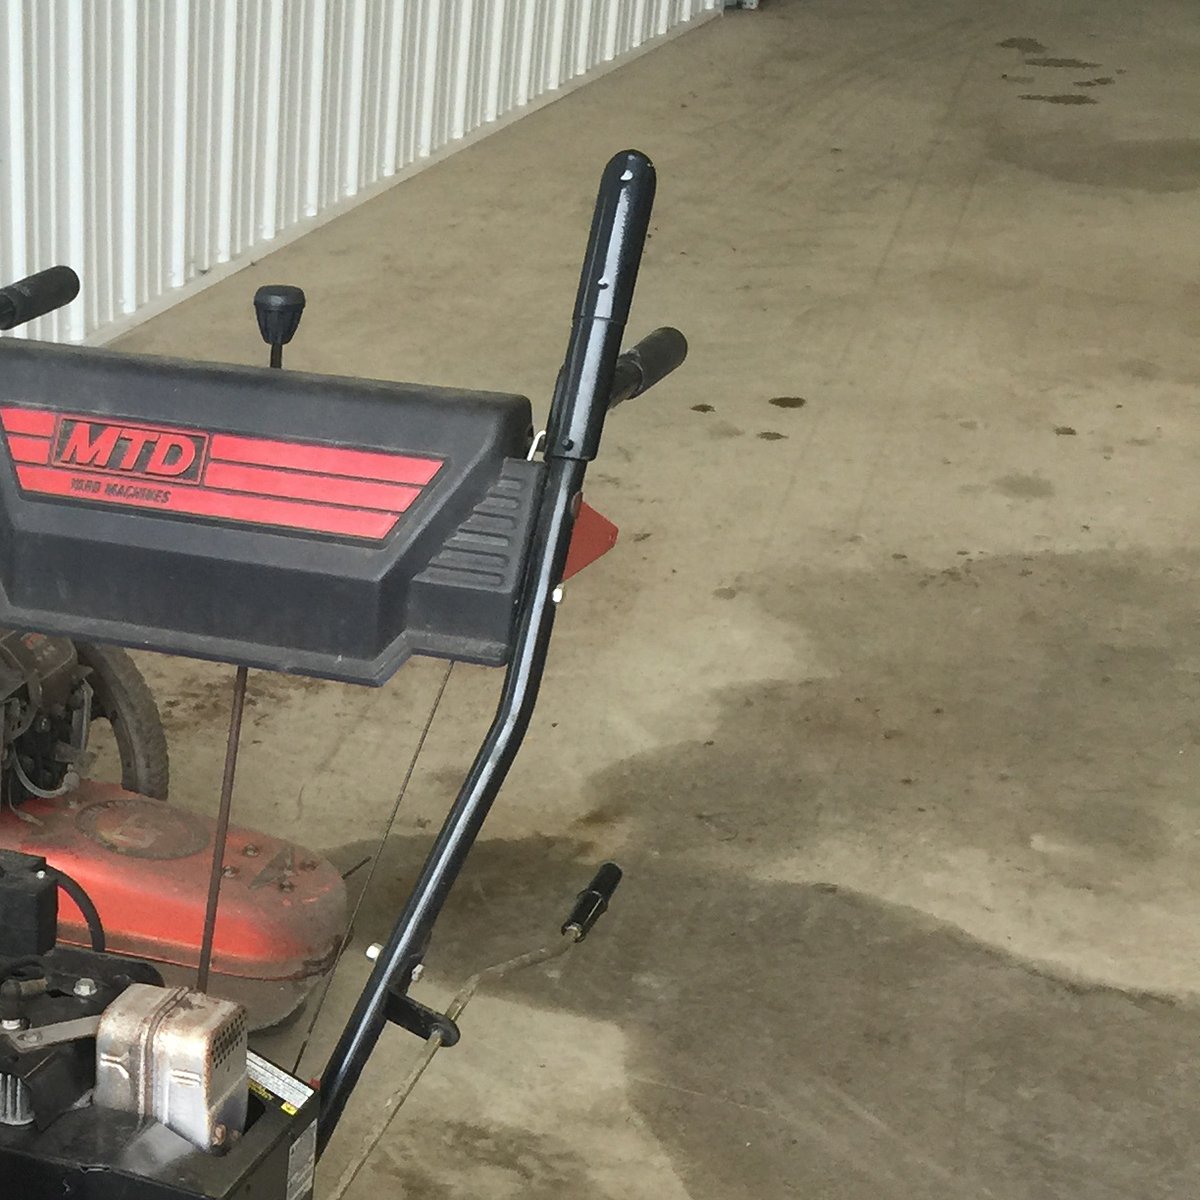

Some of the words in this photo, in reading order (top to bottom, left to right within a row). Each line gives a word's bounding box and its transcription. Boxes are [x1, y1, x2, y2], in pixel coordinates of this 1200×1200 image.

[59, 421, 197, 477] MTD
[70, 478, 102, 494] YARD
[105, 483, 172, 504] MACHINES
